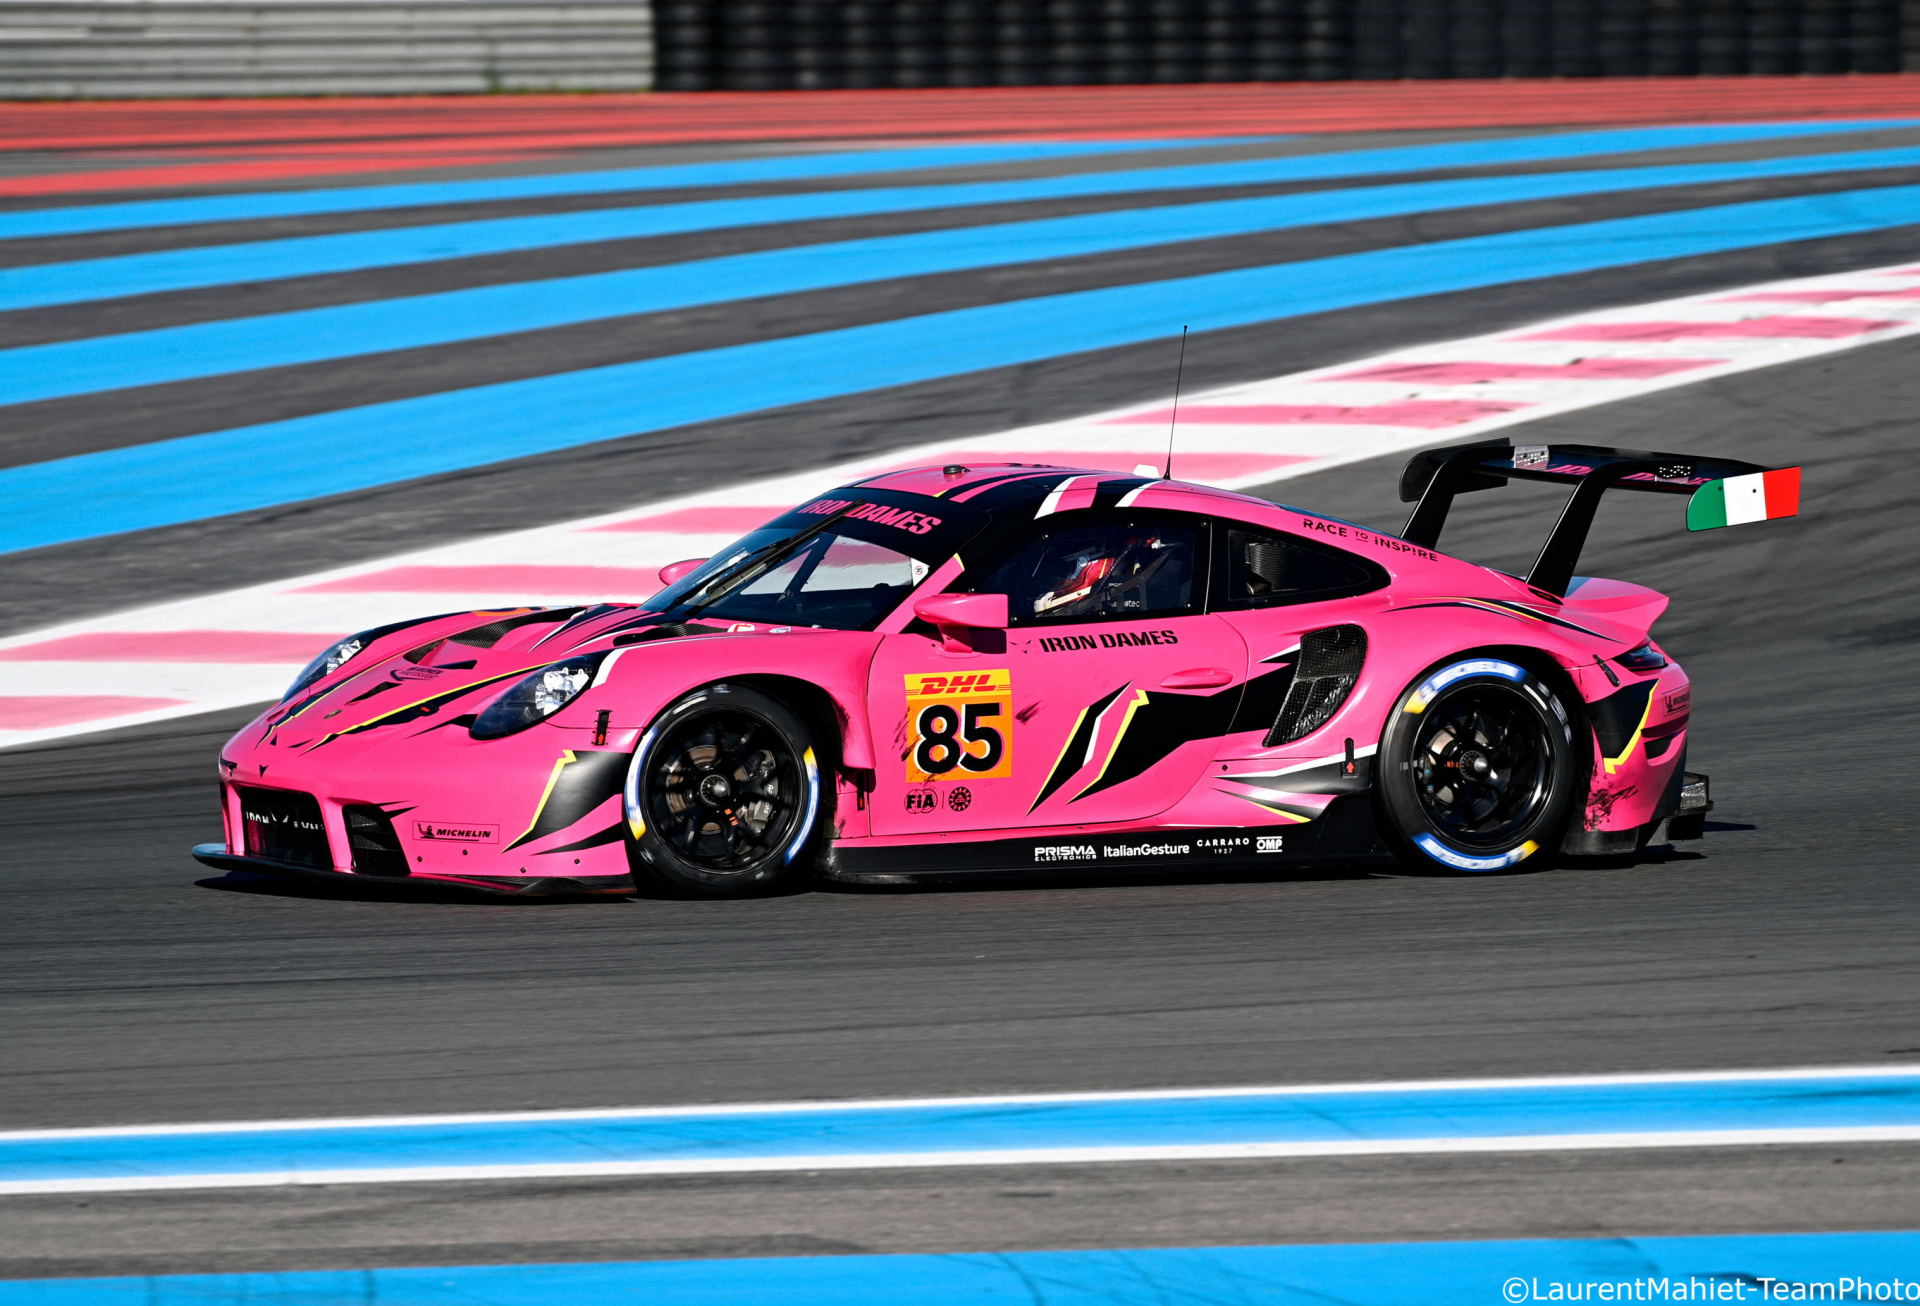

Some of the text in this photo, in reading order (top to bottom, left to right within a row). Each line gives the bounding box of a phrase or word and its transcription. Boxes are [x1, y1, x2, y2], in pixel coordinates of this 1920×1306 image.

[844, 502, 942, 535] DAMES
[1303, 518, 1348, 538] RACE
[1354, 530, 1369, 540] TO
[1039, 630, 1179, 653] IRON DAMES
[920, 674, 998, 695] DHL
[913, 702, 1006, 775] 85
[436, 828, 492, 838] MICHELIN
[1196, 837, 1250, 847] CARRARO
[1256, 839, 1283, 850] OMP
[1034, 845, 1097, 857] PRISMA
[1034, 854, 1097, 862] ELECTRONICS
[1103, 843, 1190, 858] ItalianGesture
